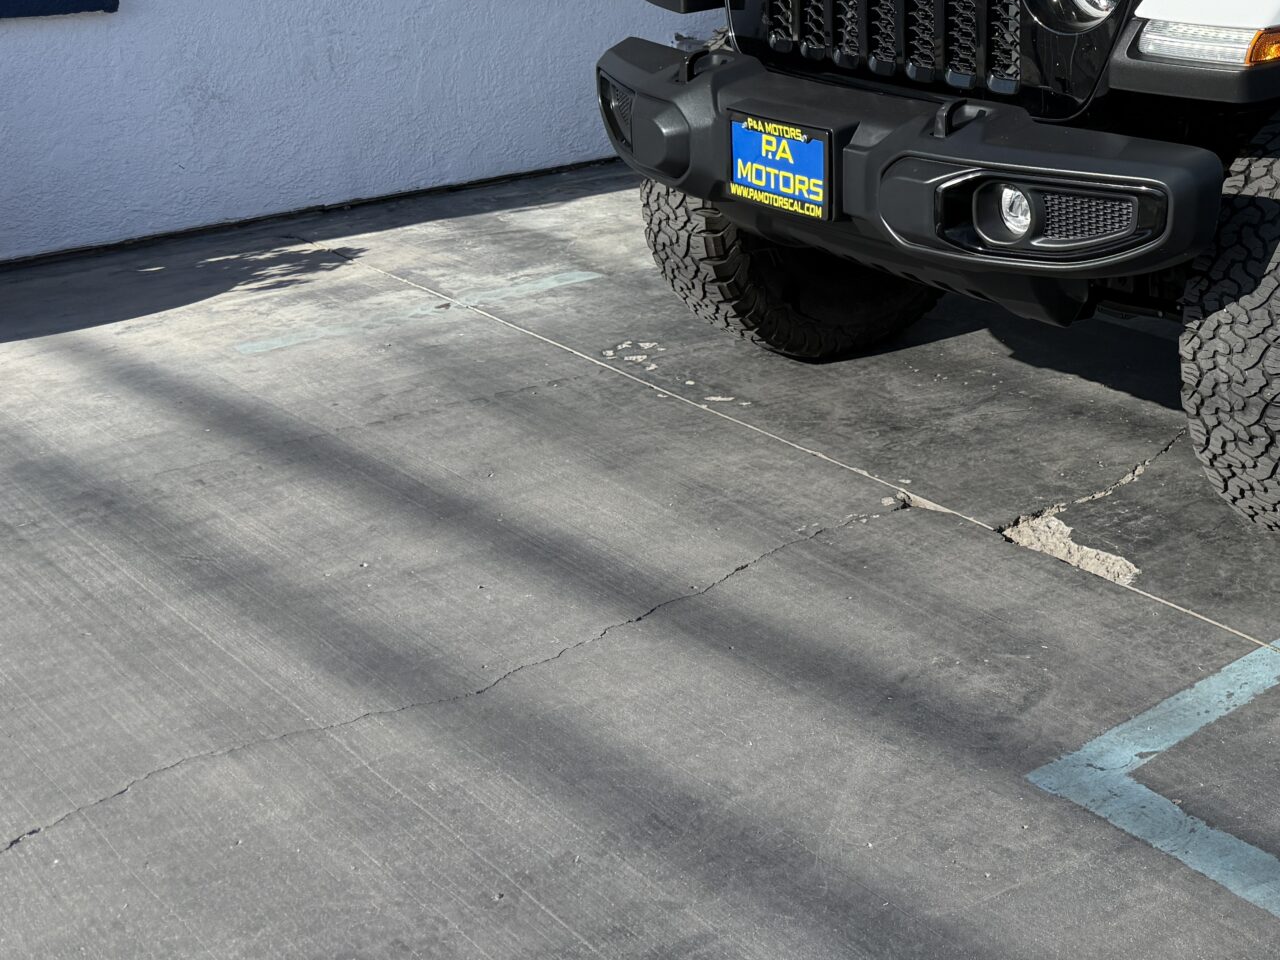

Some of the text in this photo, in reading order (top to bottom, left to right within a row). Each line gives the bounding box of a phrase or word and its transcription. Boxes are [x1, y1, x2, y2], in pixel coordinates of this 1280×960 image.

[764, 122, 803, 141] MOTORS
[737, 158, 824, 202] MOTORS
[730, 182, 823, 218] WWW.PAMOTORSCAL.COM
